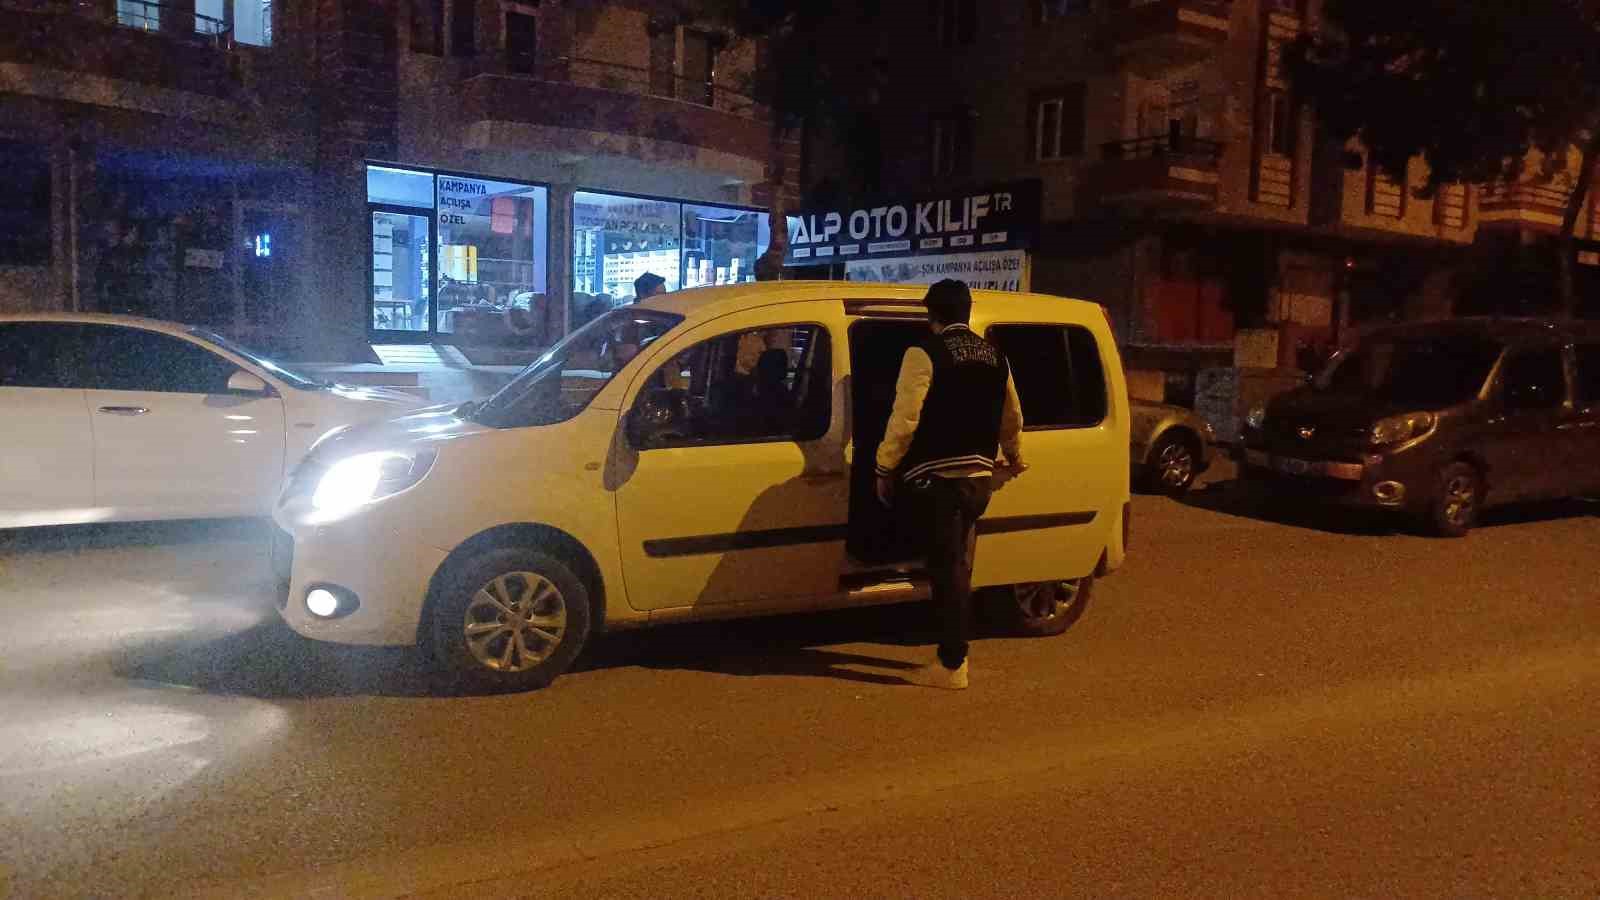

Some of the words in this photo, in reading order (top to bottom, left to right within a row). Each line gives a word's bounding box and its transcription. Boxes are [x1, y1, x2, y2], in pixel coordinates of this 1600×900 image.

[440, 180, 487, 194] KAMPANYA
[787, 212, 842, 245] ALP
[849, 205, 908, 240] OTO
[915, 195, 991, 234] KILIF
[994, 192, 1013, 212] TR
